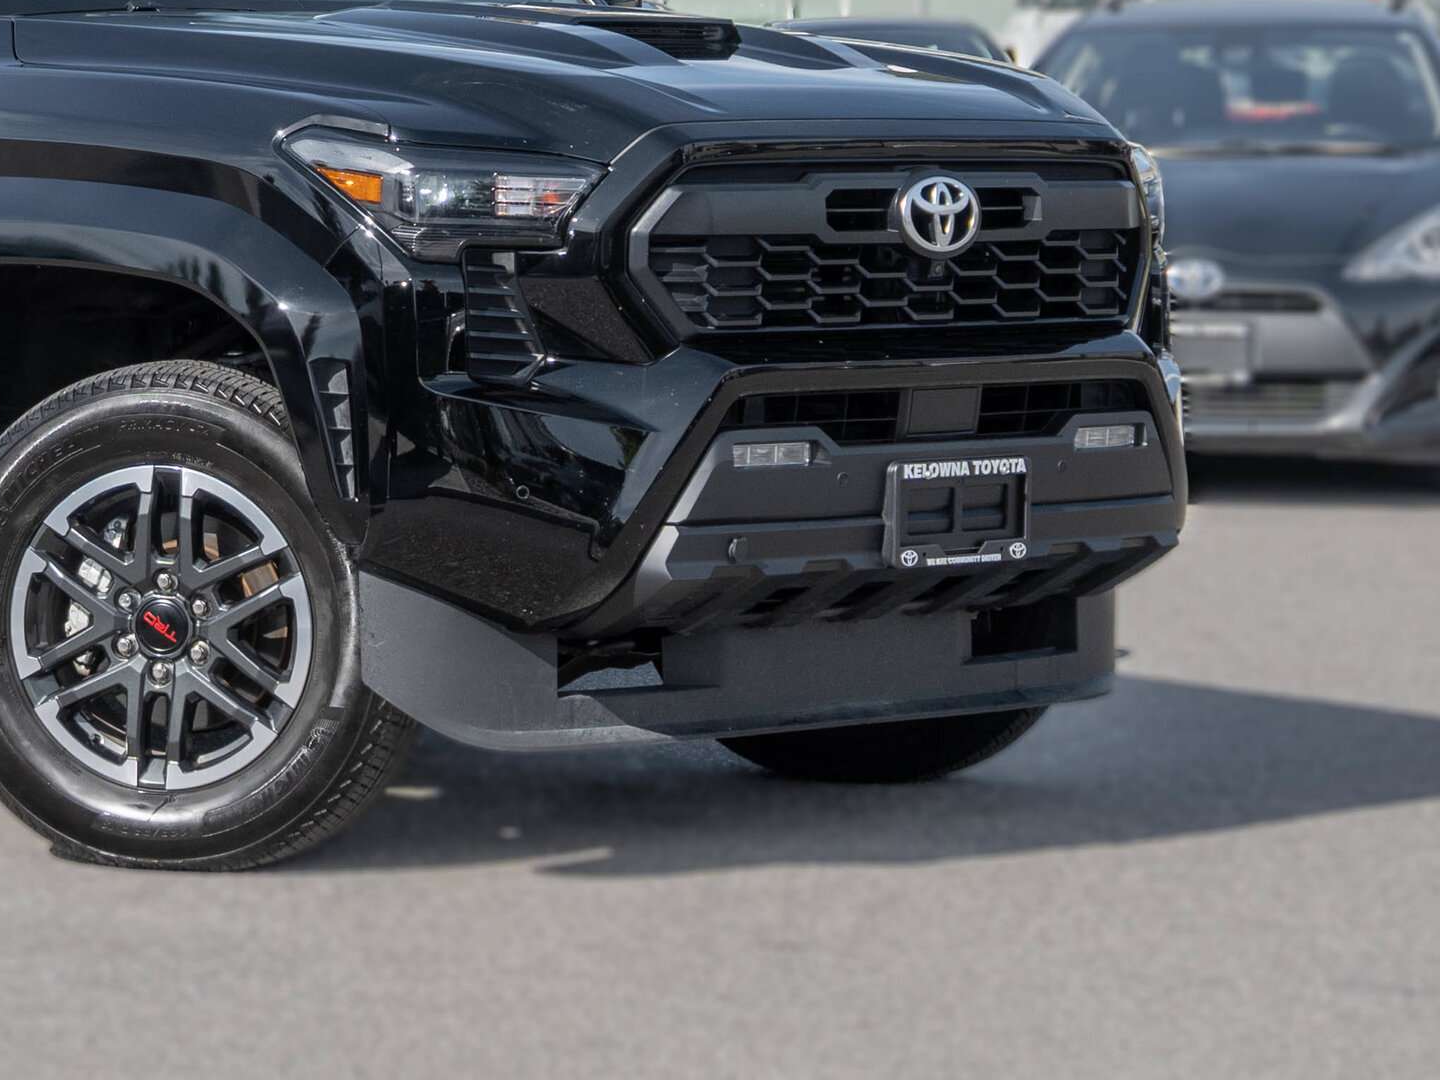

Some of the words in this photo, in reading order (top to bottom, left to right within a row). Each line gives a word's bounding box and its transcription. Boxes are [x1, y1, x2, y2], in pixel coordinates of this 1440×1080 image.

[903, 461, 970, 480] KELOWNA
[973, 458, 1027, 475] TOYOTA
[143, 611, 177, 643] TRD
